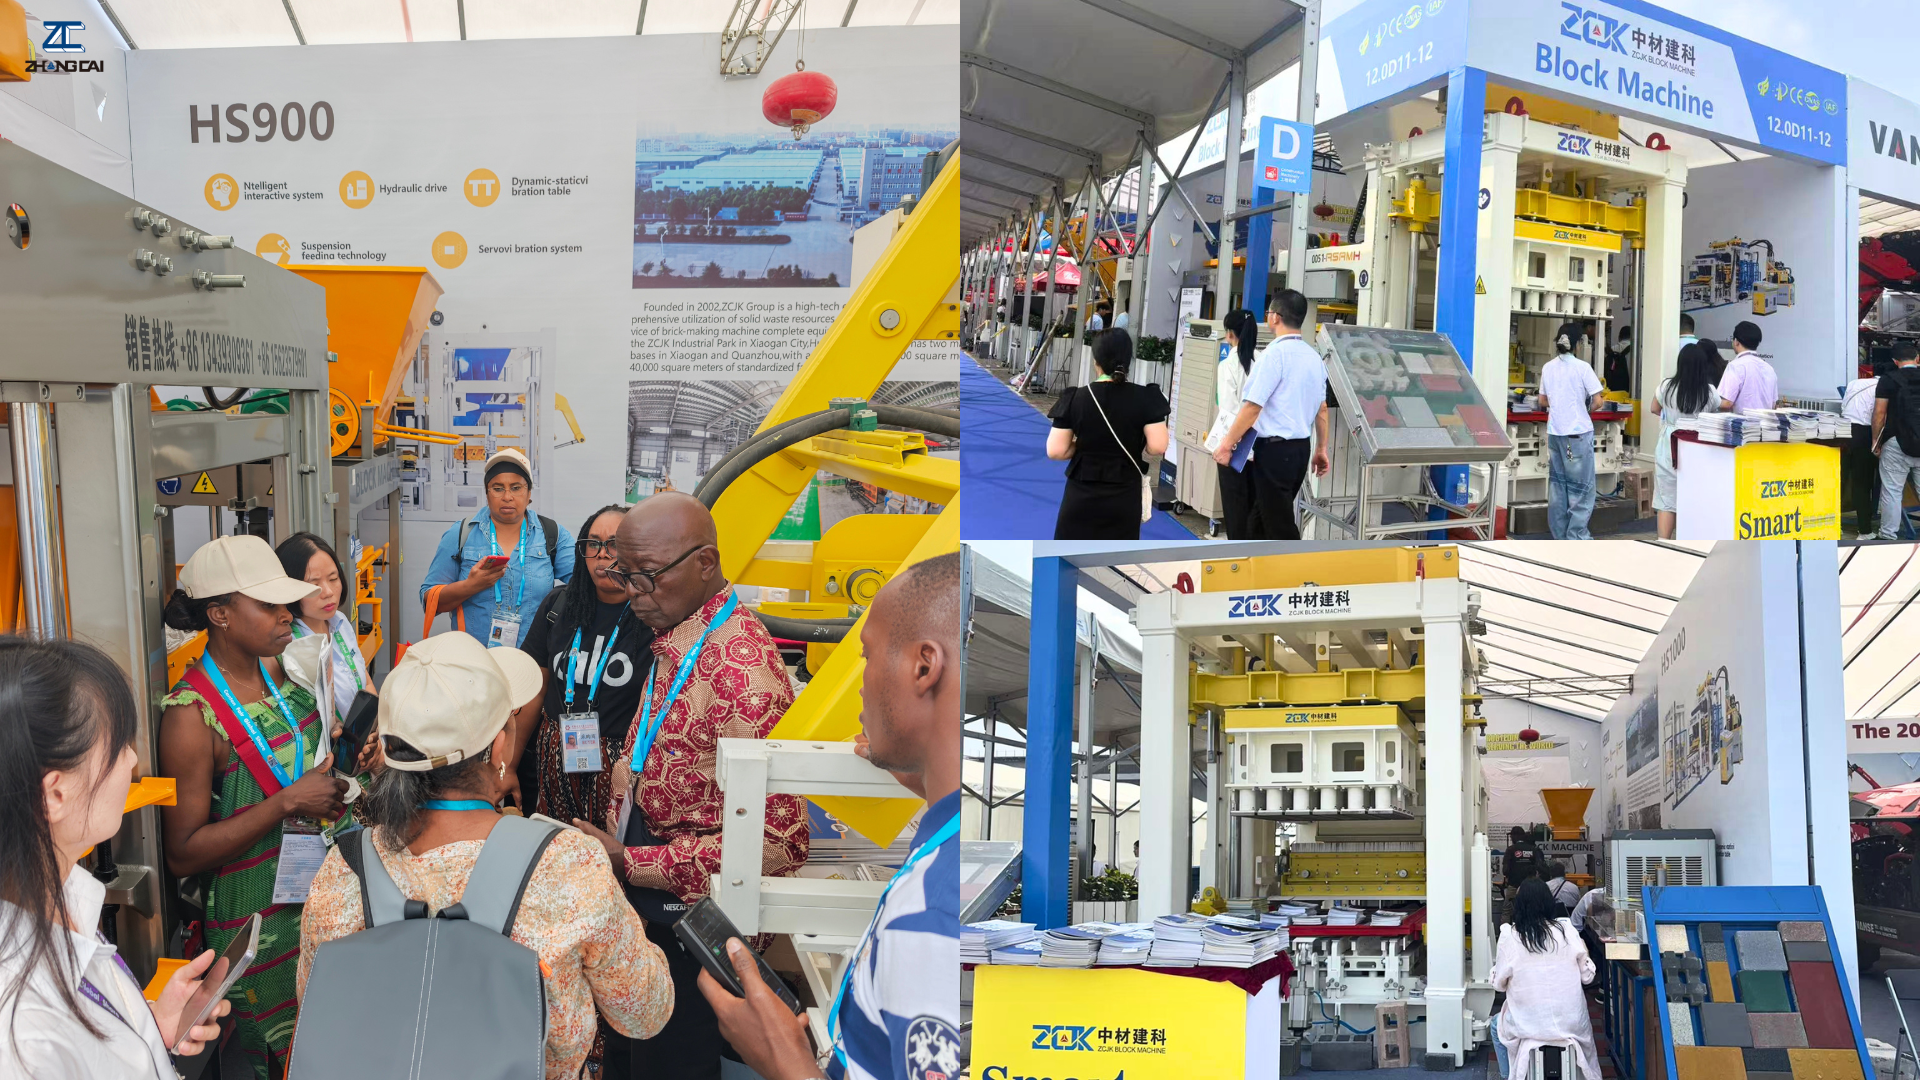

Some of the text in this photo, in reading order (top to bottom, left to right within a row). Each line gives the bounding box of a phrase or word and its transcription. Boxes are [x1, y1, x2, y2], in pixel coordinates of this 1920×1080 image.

[1632, 28, 1696, 66] 中材建科
[1366, 41, 1433, 86] 12.0D11-12
[1632, 51, 1695, 77] ZCJK BLOCK MACHINE
[1536, 42, 1714, 119] Block Machine
[190, 101, 335, 143] HS900
[1767, 116, 1831, 147] 12.0D11-12
[1272, 123, 1300, 160] D
[1595, 141, 1630, 160] 中材建科
[244, 181, 288, 192] Ntelligent
[379, 183, 447, 194] Hydraulic drive
[511, 175, 588, 187] Dynamic-staticvi
[244, 191, 323, 201] interactive system
[511, 186, 571, 196] bration table
[301, 241, 351, 252] Suspension
[337, 250, 387, 261] technology
[478, 244, 583, 255] Servovi bration system
[644, 302, 683, 311] Founded
[686, 302, 695, 311] in
[697, 302, 743, 312] 2002,ZCJK
[746, 302, 775, 313] Group
[778, 302, 785, 311] is
[795, 302, 840, 313] high-tech
[631, 315, 683, 326] prehensive
[685, 314, 724, 324] utilization
[727, 314, 737, 323] of
[739, 314, 760, 323] solid
[631, 327, 648, 336] vice
[650, 326, 660, 335] of
[662, 326, 720, 337] brick-making
[722, 326, 756, 335] machine
[759, 326, 805, 337] complete
[201, 331, 254, 374] 13439309361
[631, 339, 645, 348] the
[648, 339, 670, 347] ZCJK
[672, 338, 714, 347] Industrial
[717, 338, 736, 347] Park
[738, 338, 748, 347] in
[750, 338, 788, 350] Xiaogan
[630, 351, 656, 360] bases
[659, 351, 667, 359] in
[670, 351, 708, 362] Xiaogan
[711, 350, 729, 359] and
[731, 350, 803, 362] Quanzhou,with
[915, 352, 947, 362] square
[630, 363, 659, 373] 40,000
[661, 364, 691, 373] square
[693, 363, 724, 372] meters
[726, 362, 736, 371] of
[737, 362, 795, 371] standardized
[356, 467, 376, 497] BLOCK
[1788, 478, 1814, 490] 中材建科
[1739, 506, 1802, 540] Smart
[1229, 594, 1283, 618] ZCJK
[1289, 590, 1350, 609] 中材建科
[1661, 627, 1686, 676] HS1000
[672, 646, 699, 694] Fair Global Share
[236, 707, 244, 717] Fair
[244, 718, 256, 735] Global
[255, 736, 265, 751] Share
[1852, 723, 1890, 739] The
[1552, 843, 1594, 851] MACHINE
[1032, 1025, 1097, 1051] ZCJK
[1098, 1027, 1167, 1046] 中材建科
